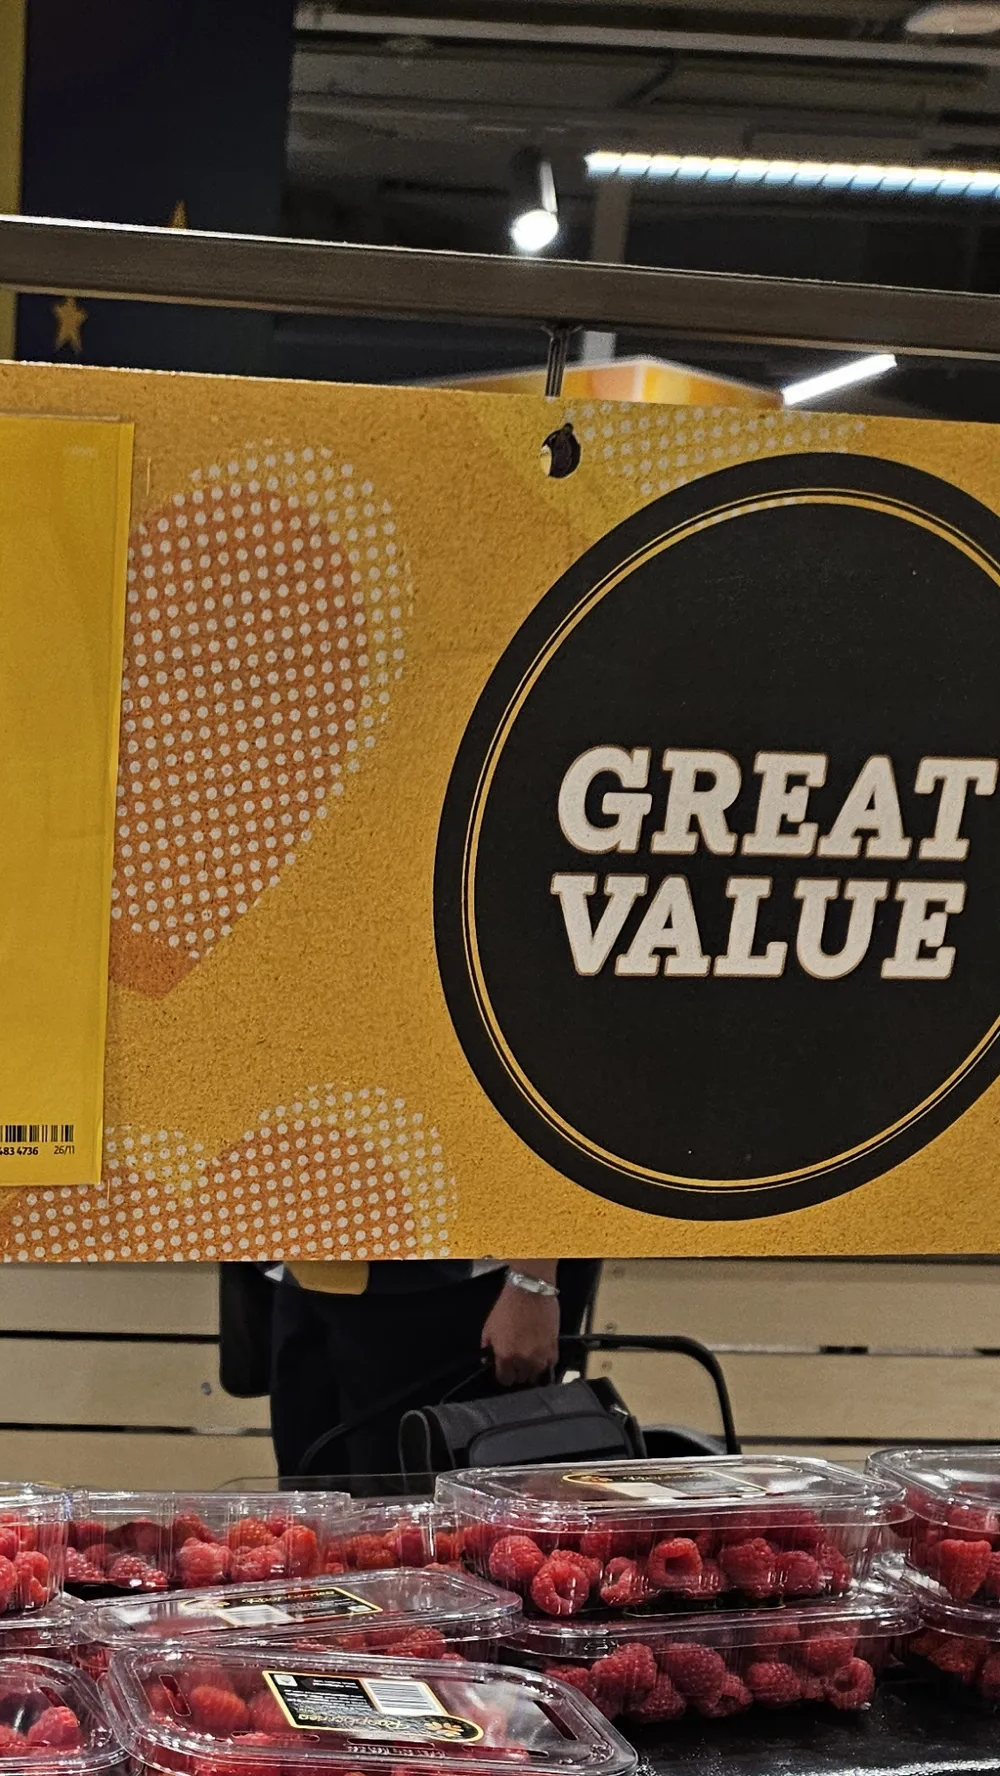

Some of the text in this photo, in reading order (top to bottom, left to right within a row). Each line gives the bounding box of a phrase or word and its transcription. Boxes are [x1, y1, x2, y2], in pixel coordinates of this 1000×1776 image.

[556, 744, 1000, 861] GREAT
[550, 871, 968, 980] VALUE
[16, 1146, 39, 1156] 4736
